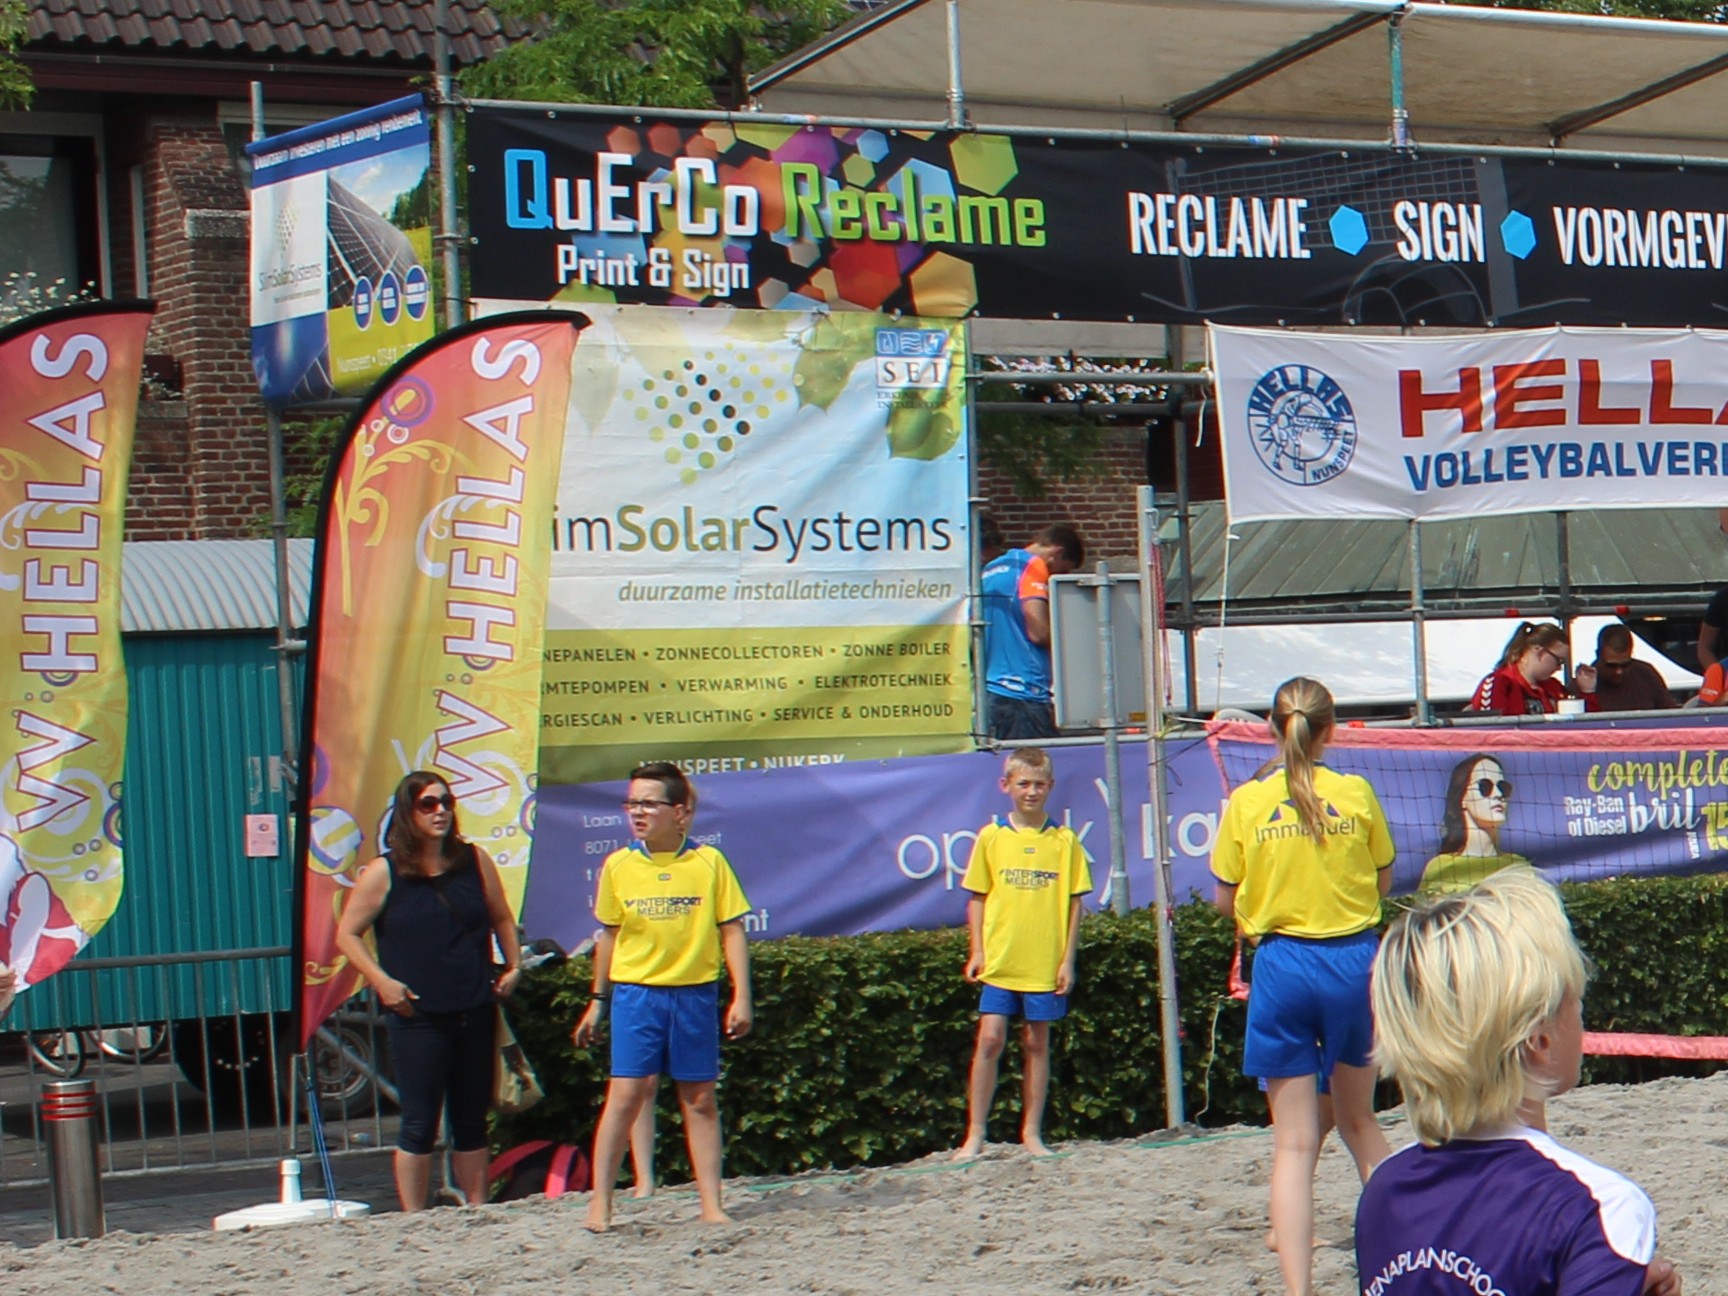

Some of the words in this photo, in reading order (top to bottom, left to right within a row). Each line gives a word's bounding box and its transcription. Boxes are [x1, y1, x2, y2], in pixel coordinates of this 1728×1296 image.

[504, 148, 759, 237] QuErCo
[780, 162, 1047, 247] Reclame
[1129, 192, 1311, 261] RECLAME
[1393, 201, 1486, 264] SIGN
[557, 244, 641, 287] Print
[648, 248, 674, 288] &
[682, 248, 750, 297] Sign
[883, 361, 943, 383] SEI
[1311, 429, 1354, 481] NUNSPEET
[21, 332, 110, 673] HELLAS
[442, 334, 542, 662] HELLAS
[552, 504, 952, 564] imSolarSystems
[618, 580, 727, 602] duurzame
[735, 578, 952, 601] installatietechnieken
[542, 648, 636, 663] NEPANELEN
[655, 645, 824, 661] ZONNECOLLECTOREN
[843, 643, 894, 657] ZONNE
[900, 642, 951, 656] BOILER
[542, 679, 649, 696] MTEPOMPEN
[677, 676, 788, 692] VERWARMING
[814, 673, 952, 689] ELEKTROTECHNIEK
[541, 712, 623, 727] RGIESCAN
[644, 708, 754, 725] VERLICHTING
[773, 706, 834, 721] SERVICE
[841, 707, 851, 720] &
[859, 704, 953, 720] ONDERHOUD
[1565, 795, 1624, 816] Ray-Ban
[1628, 787, 1701, 834] bril
[1568, 818, 1583, 837] of
[1584, 815, 1627, 836] Diesel
[637, 896, 703, 907] INTERSPORT
